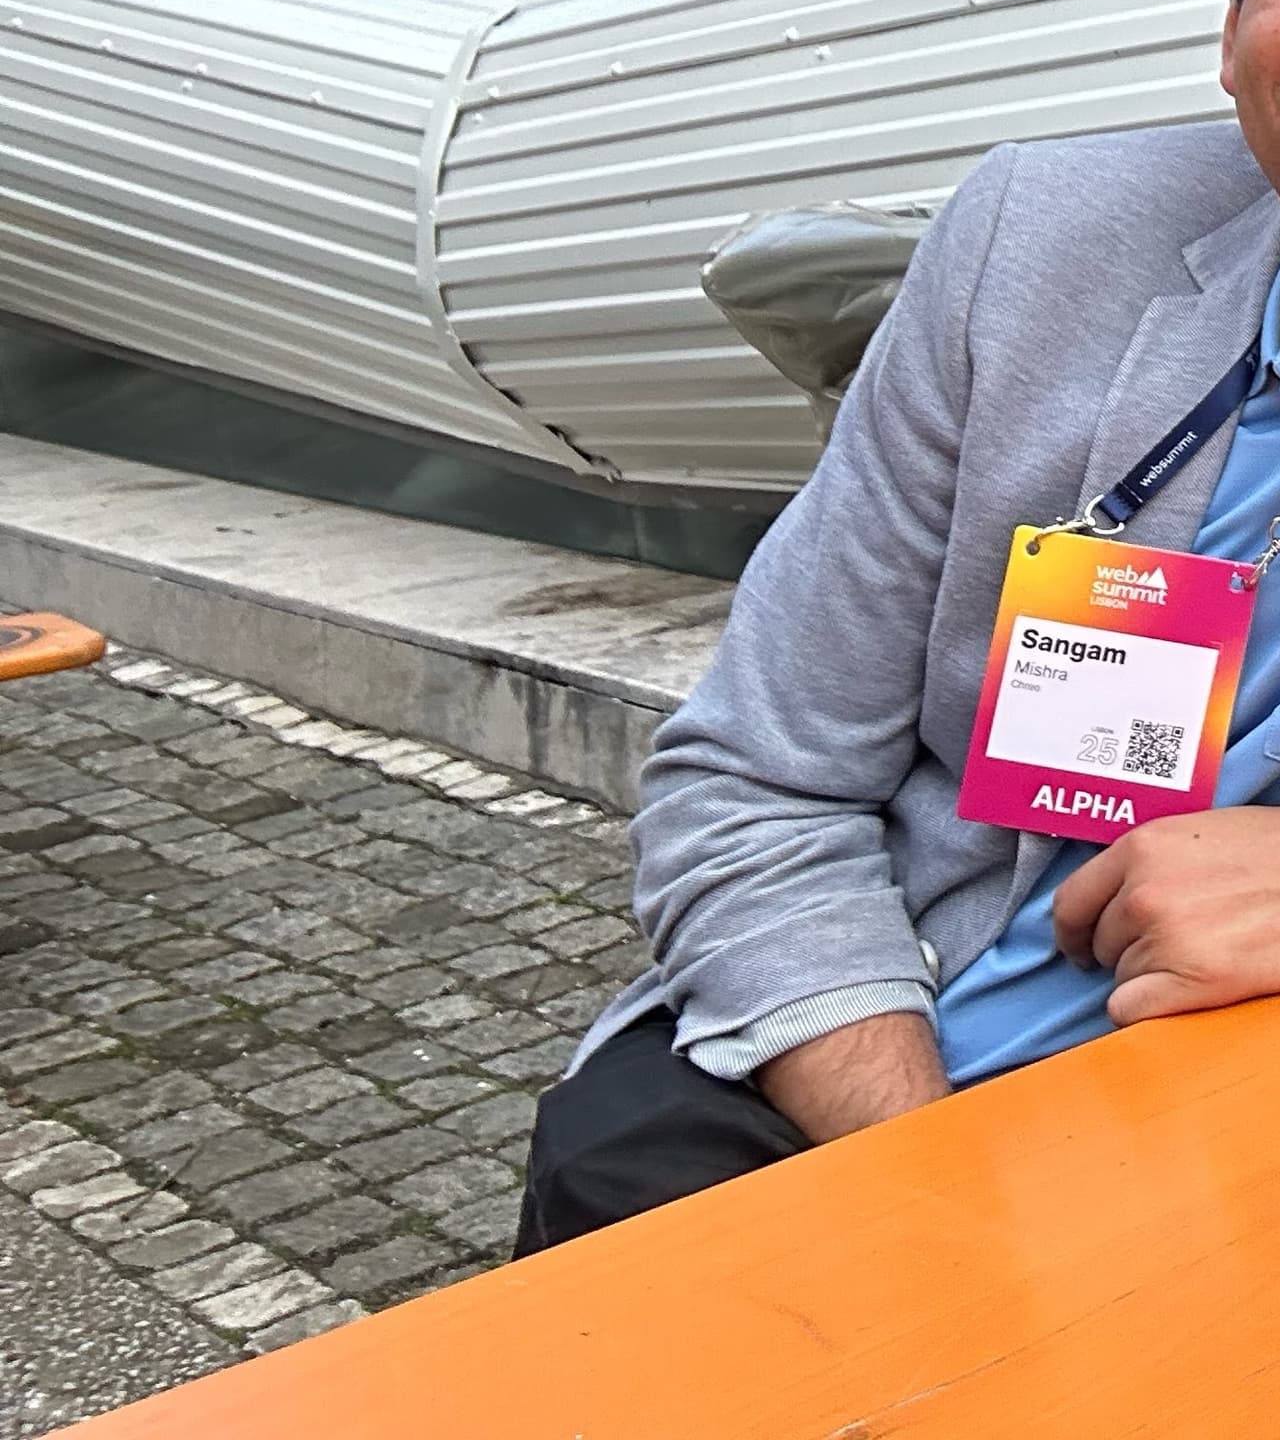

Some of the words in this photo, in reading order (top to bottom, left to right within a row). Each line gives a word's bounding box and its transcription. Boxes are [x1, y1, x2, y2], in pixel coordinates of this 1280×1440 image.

[1139, 430, 1198, 488] websummit
[1096, 564, 1138, 585] web
[1089, 596, 1128, 610] LISBON
[1091, 580, 1168, 606] summit
[1021, 628, 1127, 665] Sangam
[1014, 659, 1068, 682] Mishra
[1077, 733, 1120, 766] 25
[1030, 784, 1136, 825] ALPHA
